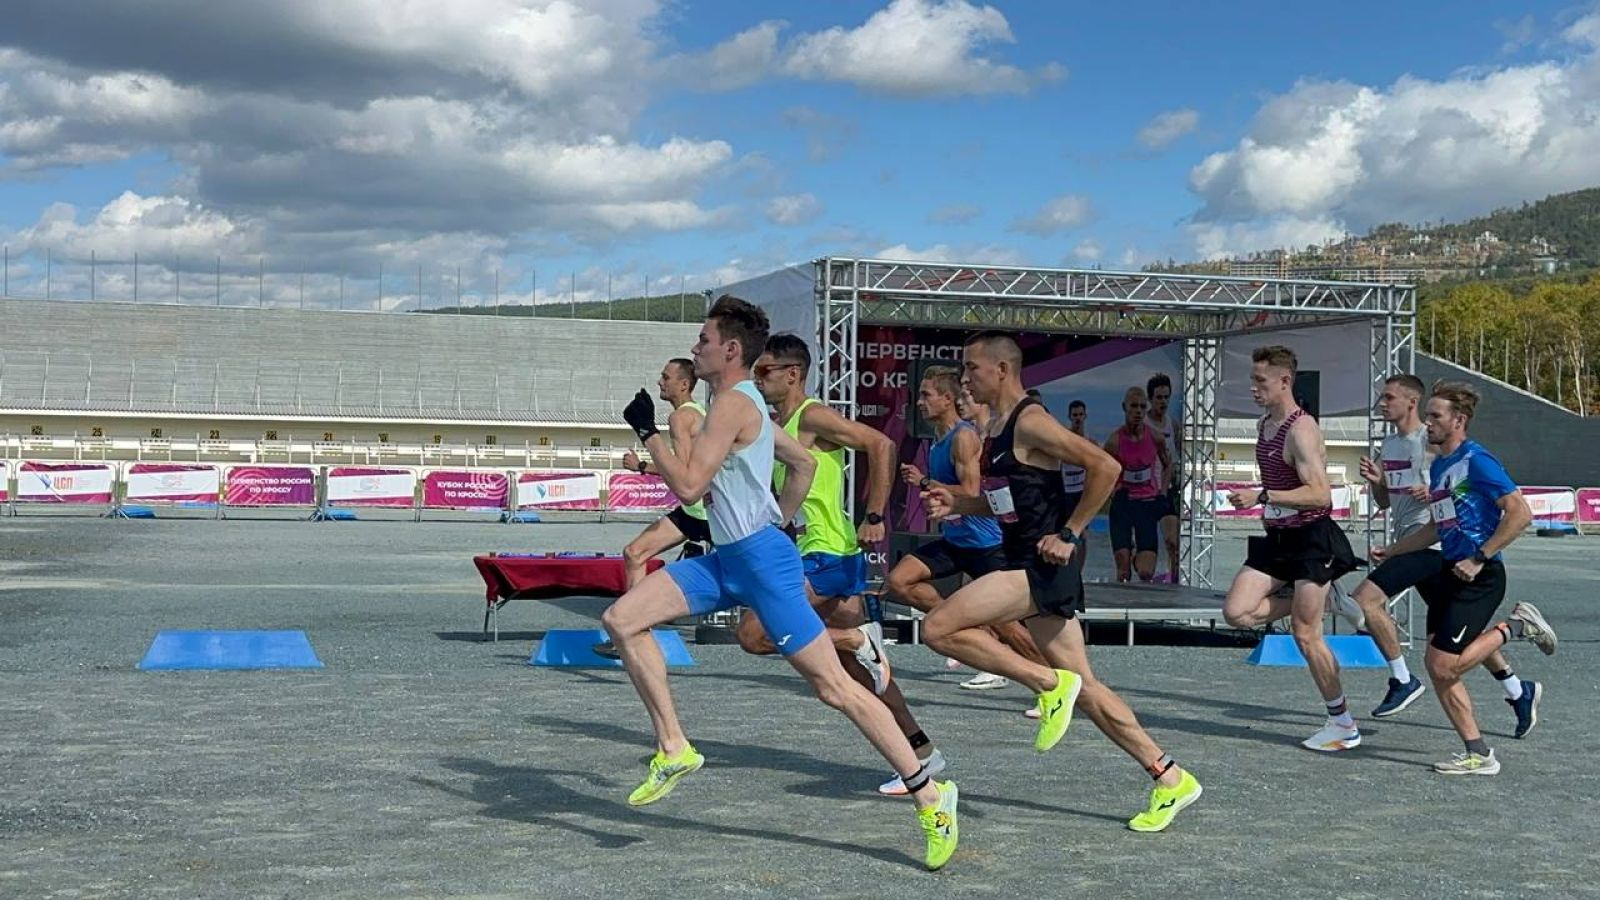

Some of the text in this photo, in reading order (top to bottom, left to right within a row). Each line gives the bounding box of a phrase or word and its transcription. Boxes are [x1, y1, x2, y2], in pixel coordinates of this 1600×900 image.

[856, 342, 965, 360] ПЕРВЕНСТ
[883, 373, 907, 388] КР
[1389, 472, 1402, 486] 17
